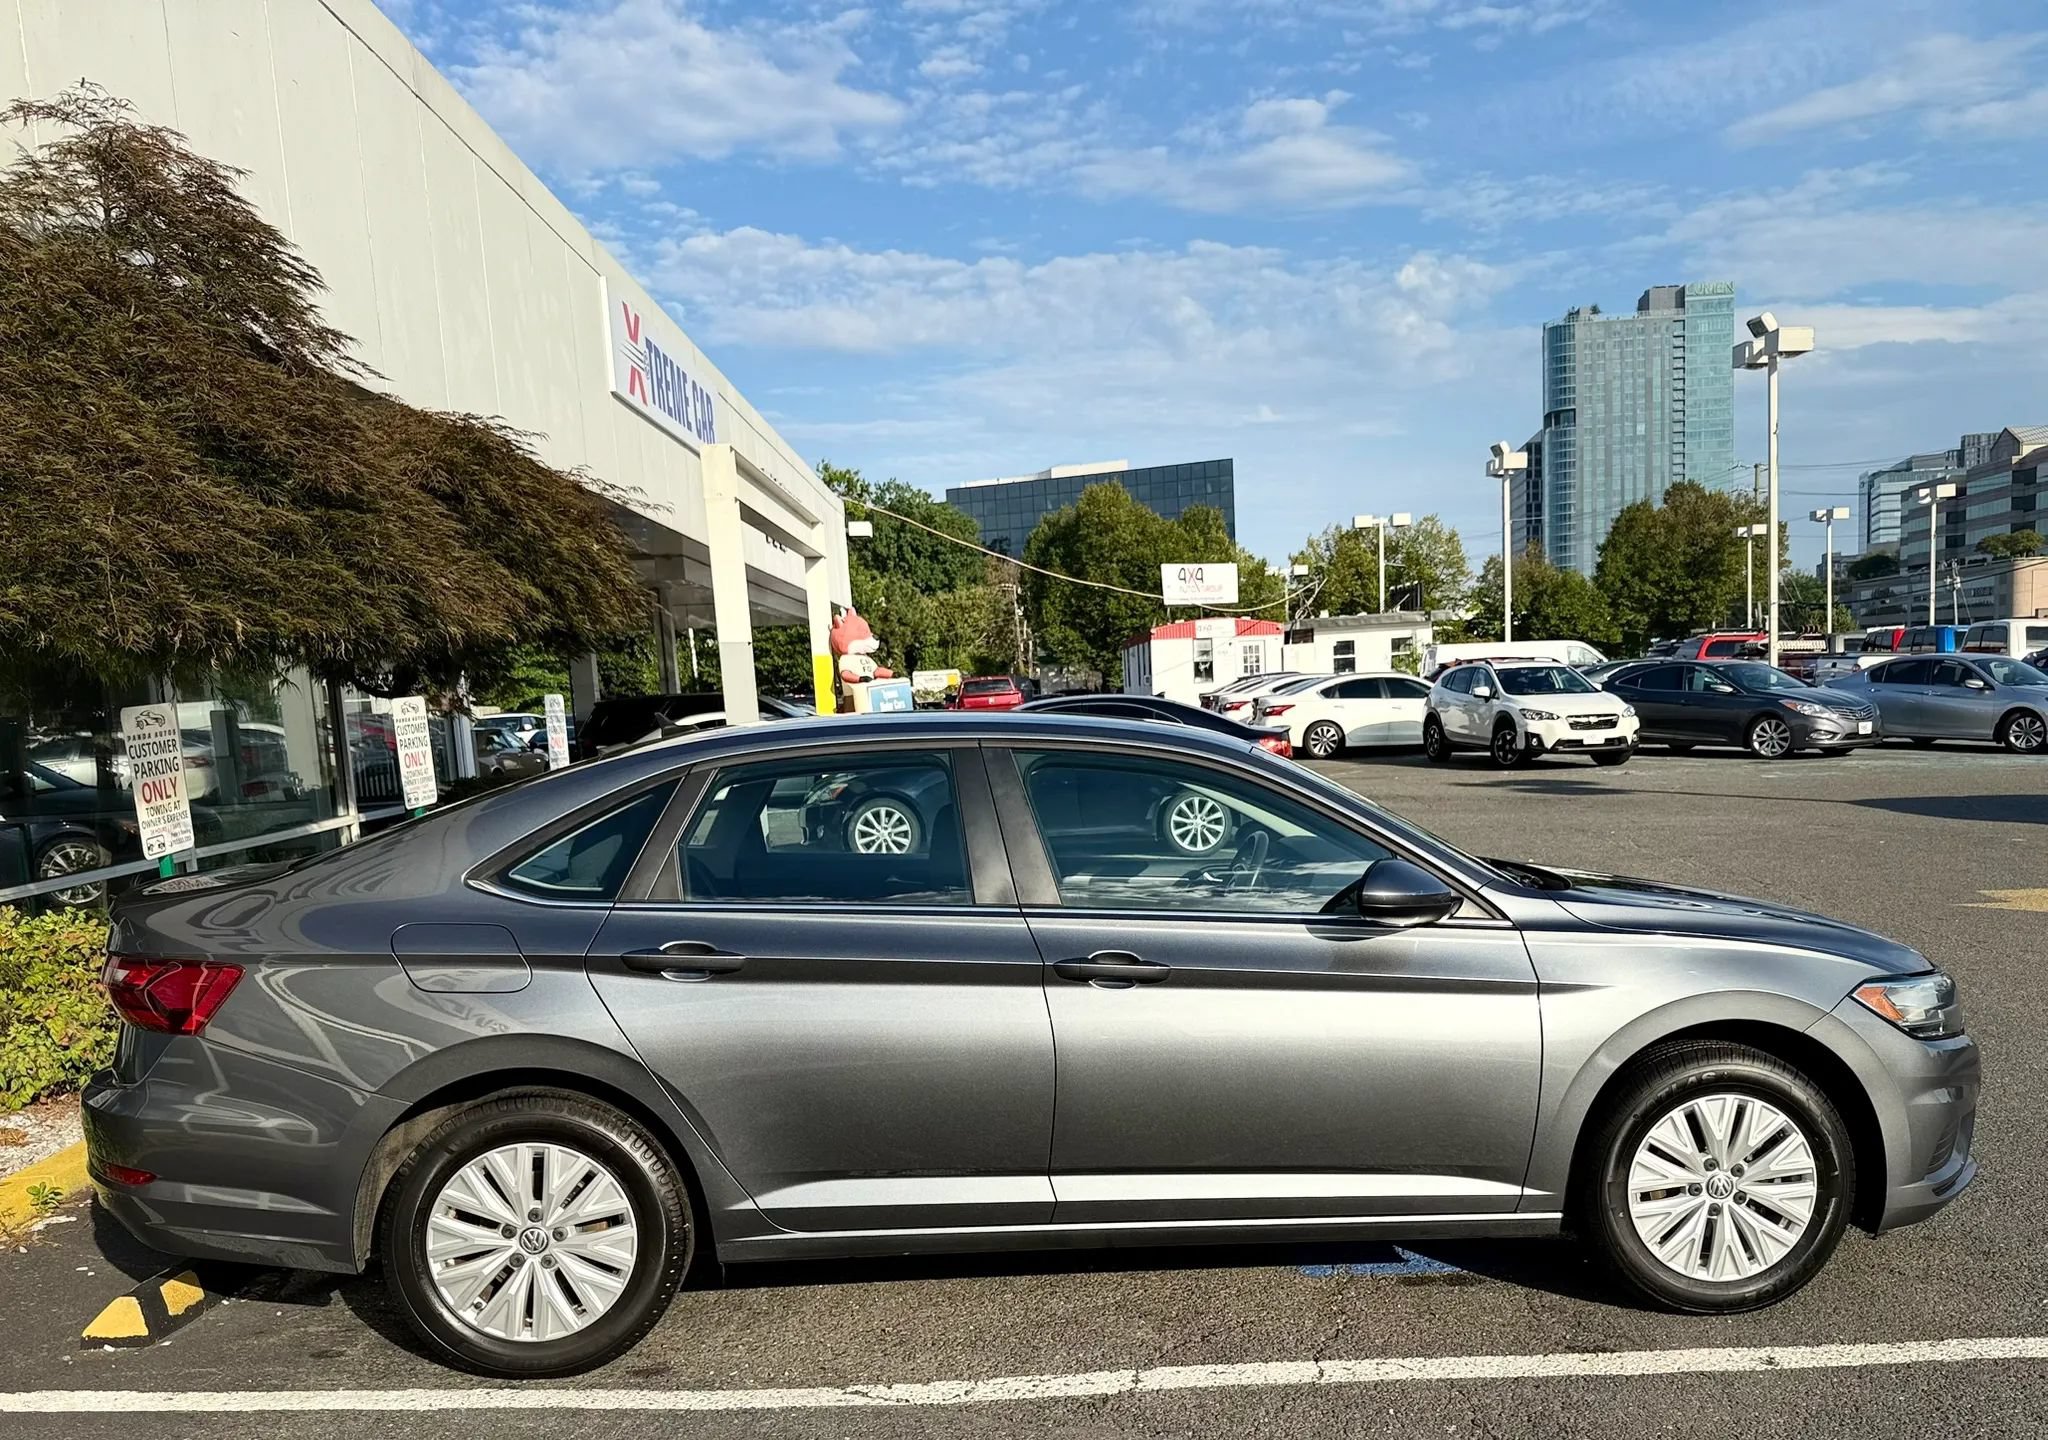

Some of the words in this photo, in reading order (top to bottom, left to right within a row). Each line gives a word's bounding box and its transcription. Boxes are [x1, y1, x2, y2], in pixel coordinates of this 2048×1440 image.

[691, 379, 715, 444] CAR
[128, 732, 151, 742] PANDA
[154, 729, 177, 739] AUTOS
[396, 722, 427, 737] CUSTOMER
[128, 739, 178, 760] CUSTOMER
[400, 736, 428, 751] PARKING
[134, 756, 180, 780] PARKING
[404, 750, 427, 769] ONLY
[142, 776, 178, 804] ONLY
[146, 802, 172, 818] TOWING
[174, 800, 181, 811] AT
[142, 815, 166, 830] OWNER'S
[166, 810, 188, 824] EXPENSE
